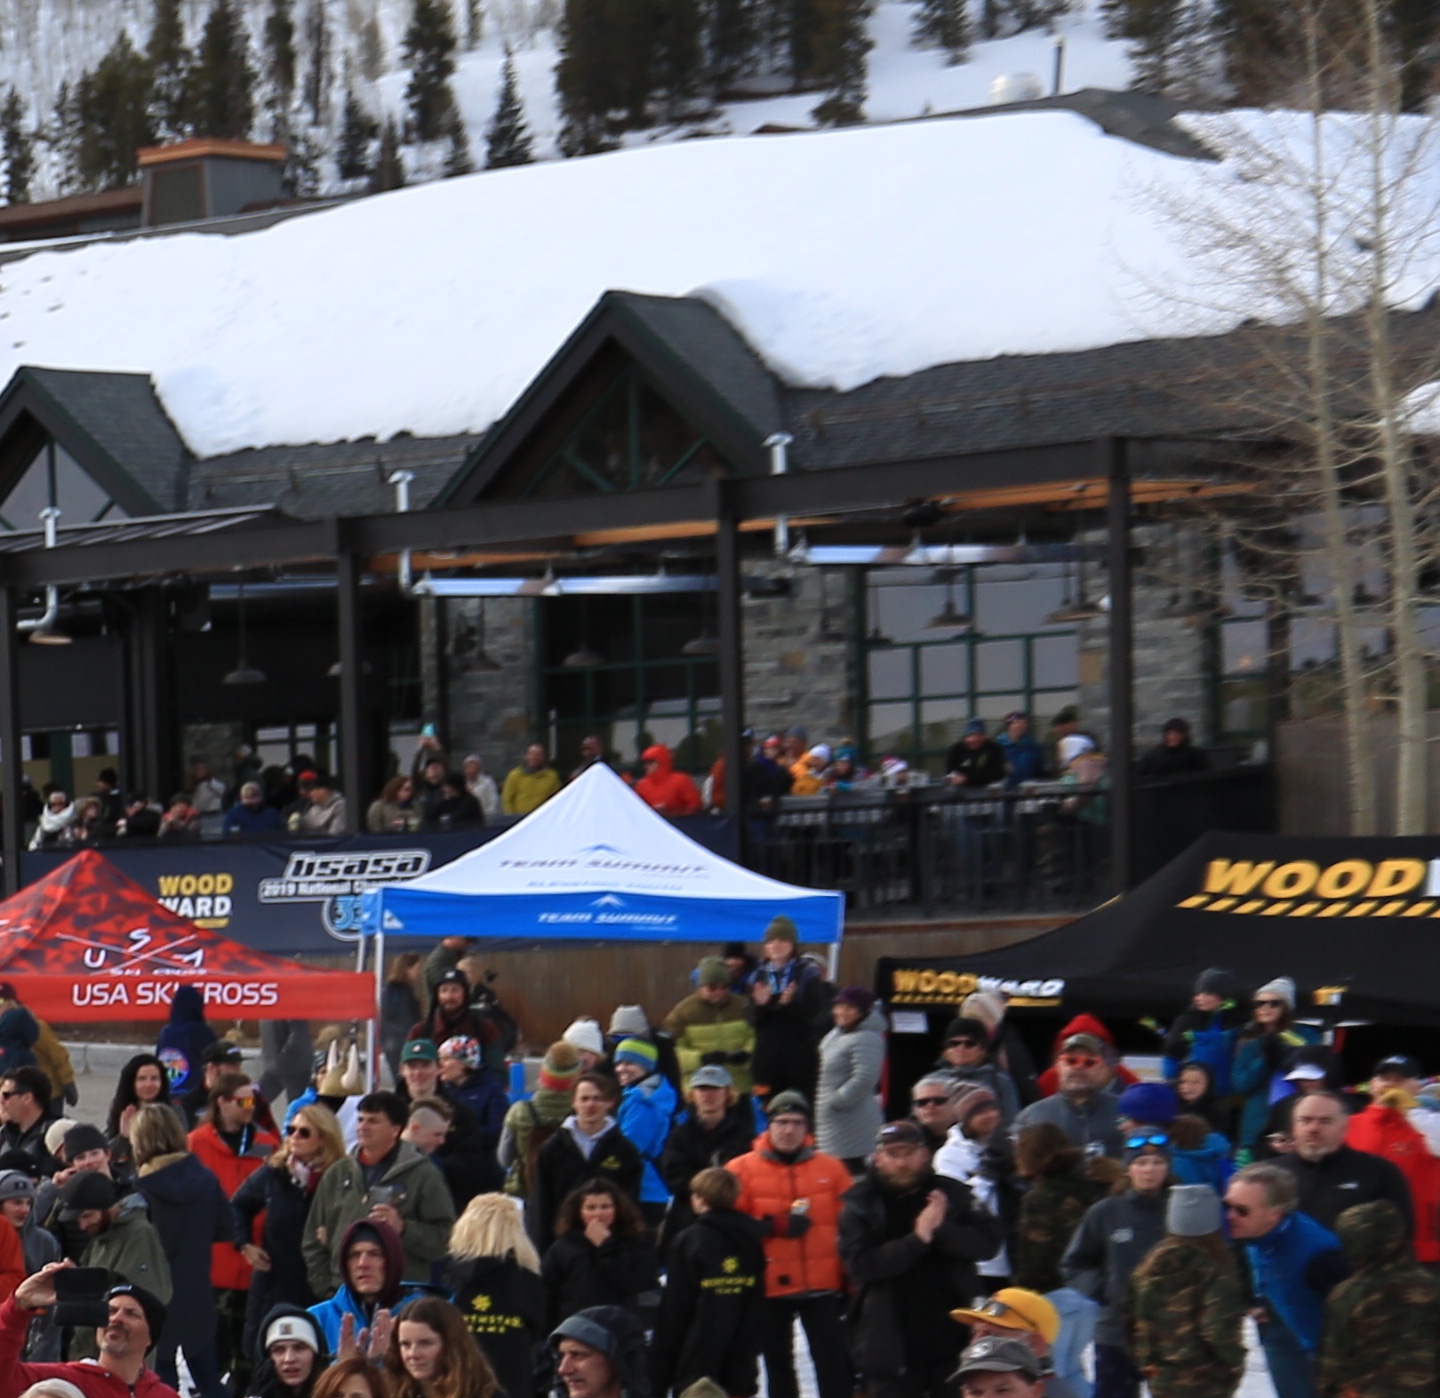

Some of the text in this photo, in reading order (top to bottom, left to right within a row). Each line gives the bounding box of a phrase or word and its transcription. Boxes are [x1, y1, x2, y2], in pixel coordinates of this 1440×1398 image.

[159, 874, 233, 896] WOOD
[263, 884, 296, 899] 2019
[298, 882, 350, 897] National
[159, 895, 233, 919] WARD
[68, 982, 127, 1006] USA
